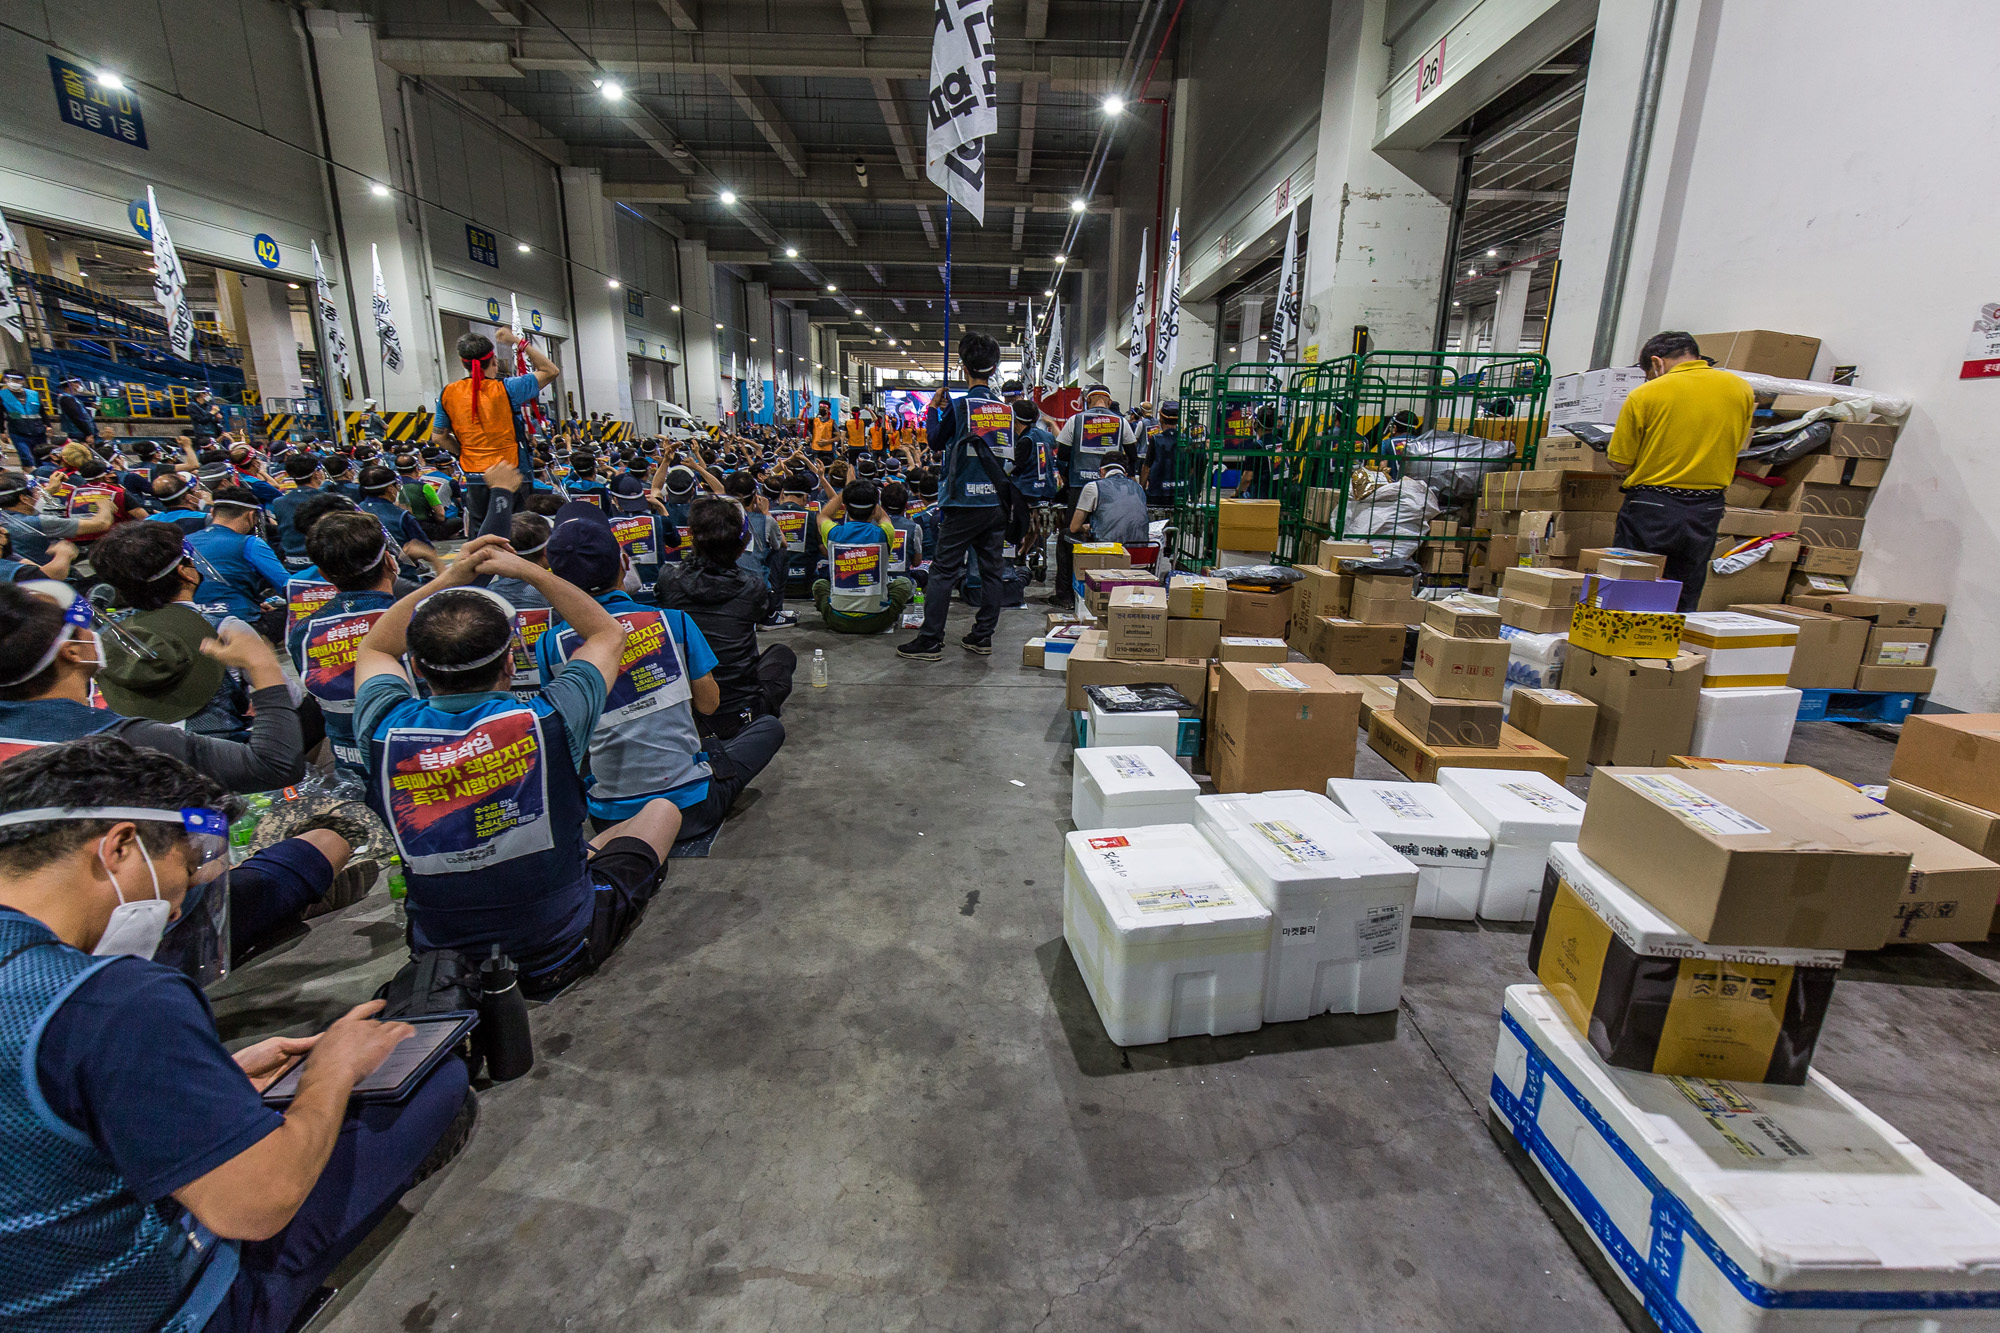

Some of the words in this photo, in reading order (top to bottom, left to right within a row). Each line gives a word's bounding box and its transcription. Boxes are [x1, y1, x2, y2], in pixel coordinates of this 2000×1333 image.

[1422, 57, 1438, 92] 26
[69, 99, 102, 129] B동
[109, 115, 137, 141] 1층
[258, 240, 277, 263] 42
[489, 302, 498, 316] 44
[532, 315, 541, 328] 45
[327, 619, 370, 642] 분류작업
[308, 643, 350, 658] 택배사가
[320, 655, 341, 668] 즉각
[392, 766, 462, 791] 택배사가
[463, 735, 538, 774] 책임지고
[419, 732, 495, 771] 분류작업
[412, 787, 450, 806] 즉각
[454, 758, 530, 797] 시행하라!
[1573, 882, 1600, 913] GODIVA
[1282, 925, 1316, 936] 마켓컬리
[1605, 913, 1636, 947] GODIVA
[1649, 945, 1706, 960] GODIVA
[1721, 953, 1780, 968] GODIVA
